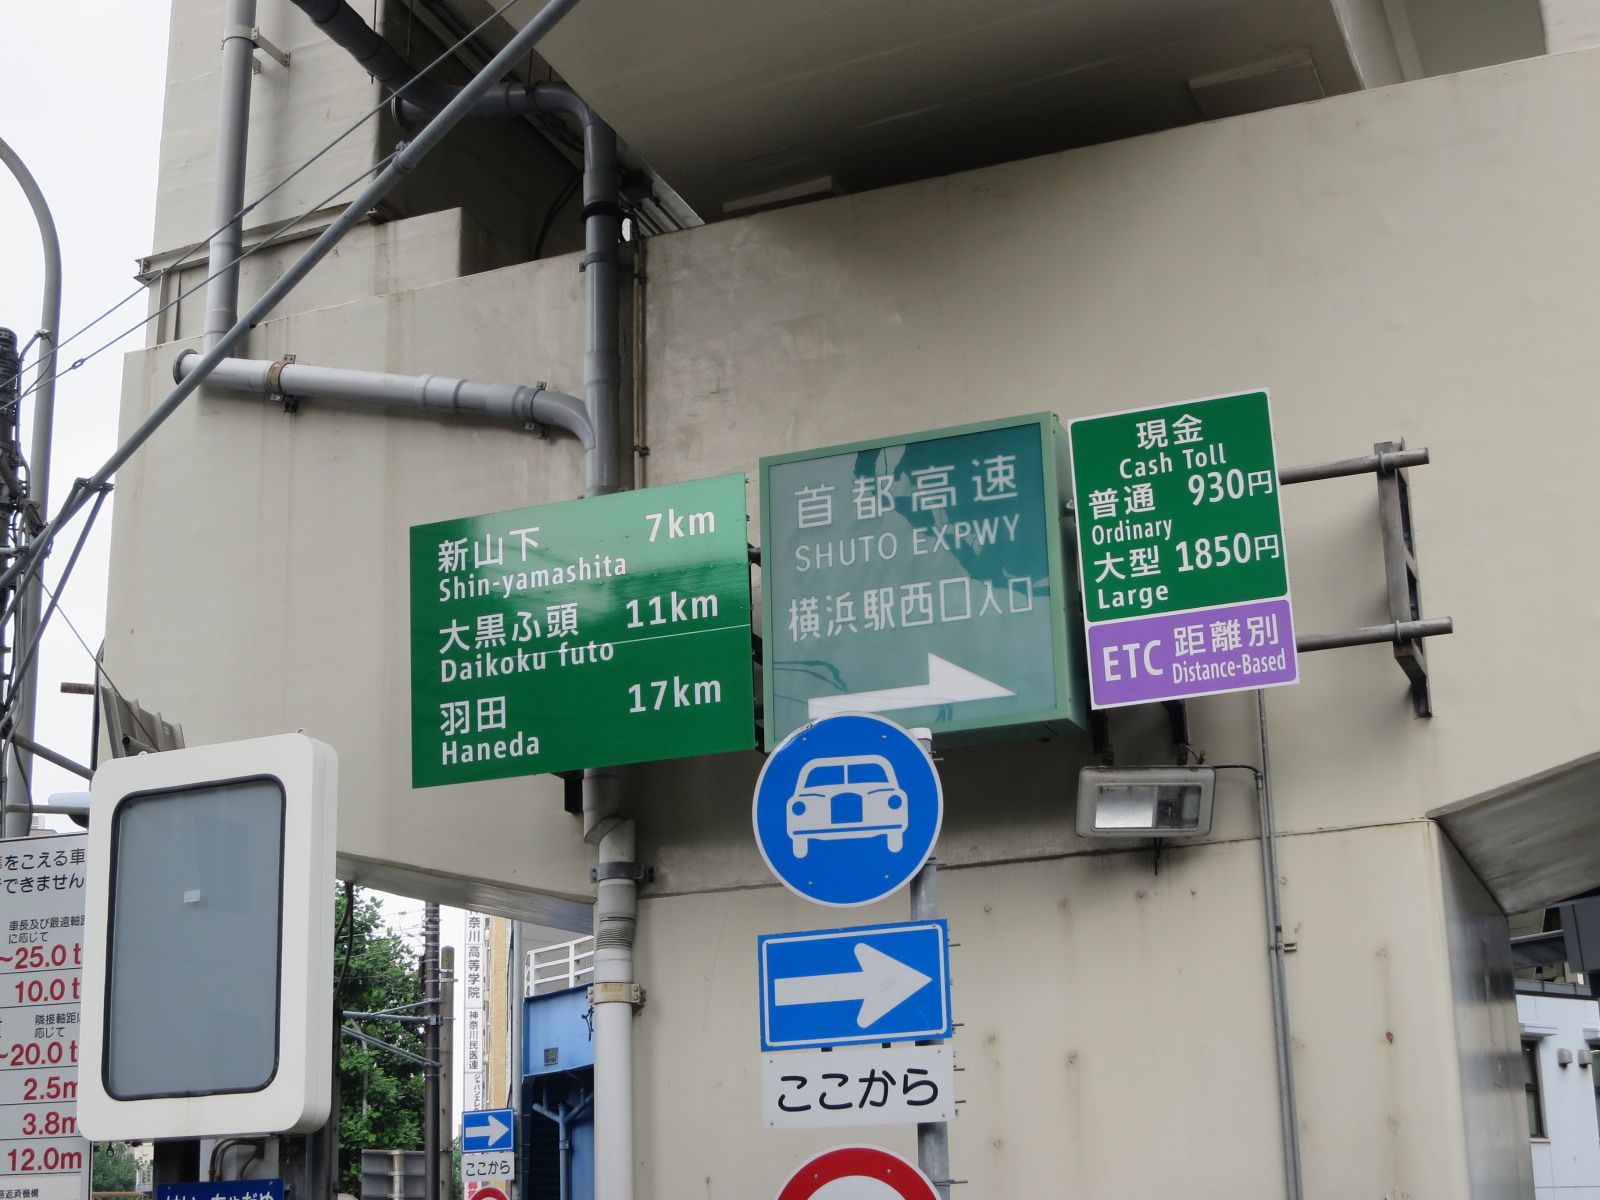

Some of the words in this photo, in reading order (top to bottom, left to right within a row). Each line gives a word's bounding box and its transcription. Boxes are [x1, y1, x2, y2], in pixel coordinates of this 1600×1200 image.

[1136, 413, 1203, 450] 現金
[1119, 452, 1173, 479] Cash
[1182, 443, 1226, 470] Toll
[794, 455, 1018, 529] 首都高速
[1088, 482, 1156, 520] 普通
[1188, 469, 1274, 506] 930円
[438, 526, 540, 574] 新山下
[645, 508, 715, 543] 7km
[795, 532, 897, 572] SHUTO
[912, 513, 1020, 555] EXPWY
[1091, 519, 1173, 545] Ordinary
[439, 555, 627, 602] Shin-yamashita
[1093, 545, 1162, 584] 大型
[1175, 532, 1280, 572] 1850円
[788, 576, 1033, 642] 横浜駅西口入口
[1098, 584, 1169, 609] Large
[439, 602, 579, 654] 大黒ふ頭
[625, 591, 719, 629] 11km
[1173, 613, 1280, 657] 距離別
[441, 647, 547, 683] Daikoku
[558, 641, 615, 667] futo
[1103, 639, 1164, 682] ETC
[1172, 648, 1286, 684] Distance-Based
[439, 695, 507, 737] 羽田
[628, 676, 722, 714] 17km
[441, 731, 540, 766] Haneda
[0, 848, 85, 871] をこえる車
[0, 873, 85, 894] できません
[778, 1068, 939, 1112] ここから
[8, 1147, 82, 1172] 12.0m
[466, 1160, 511, 1177] ここから
